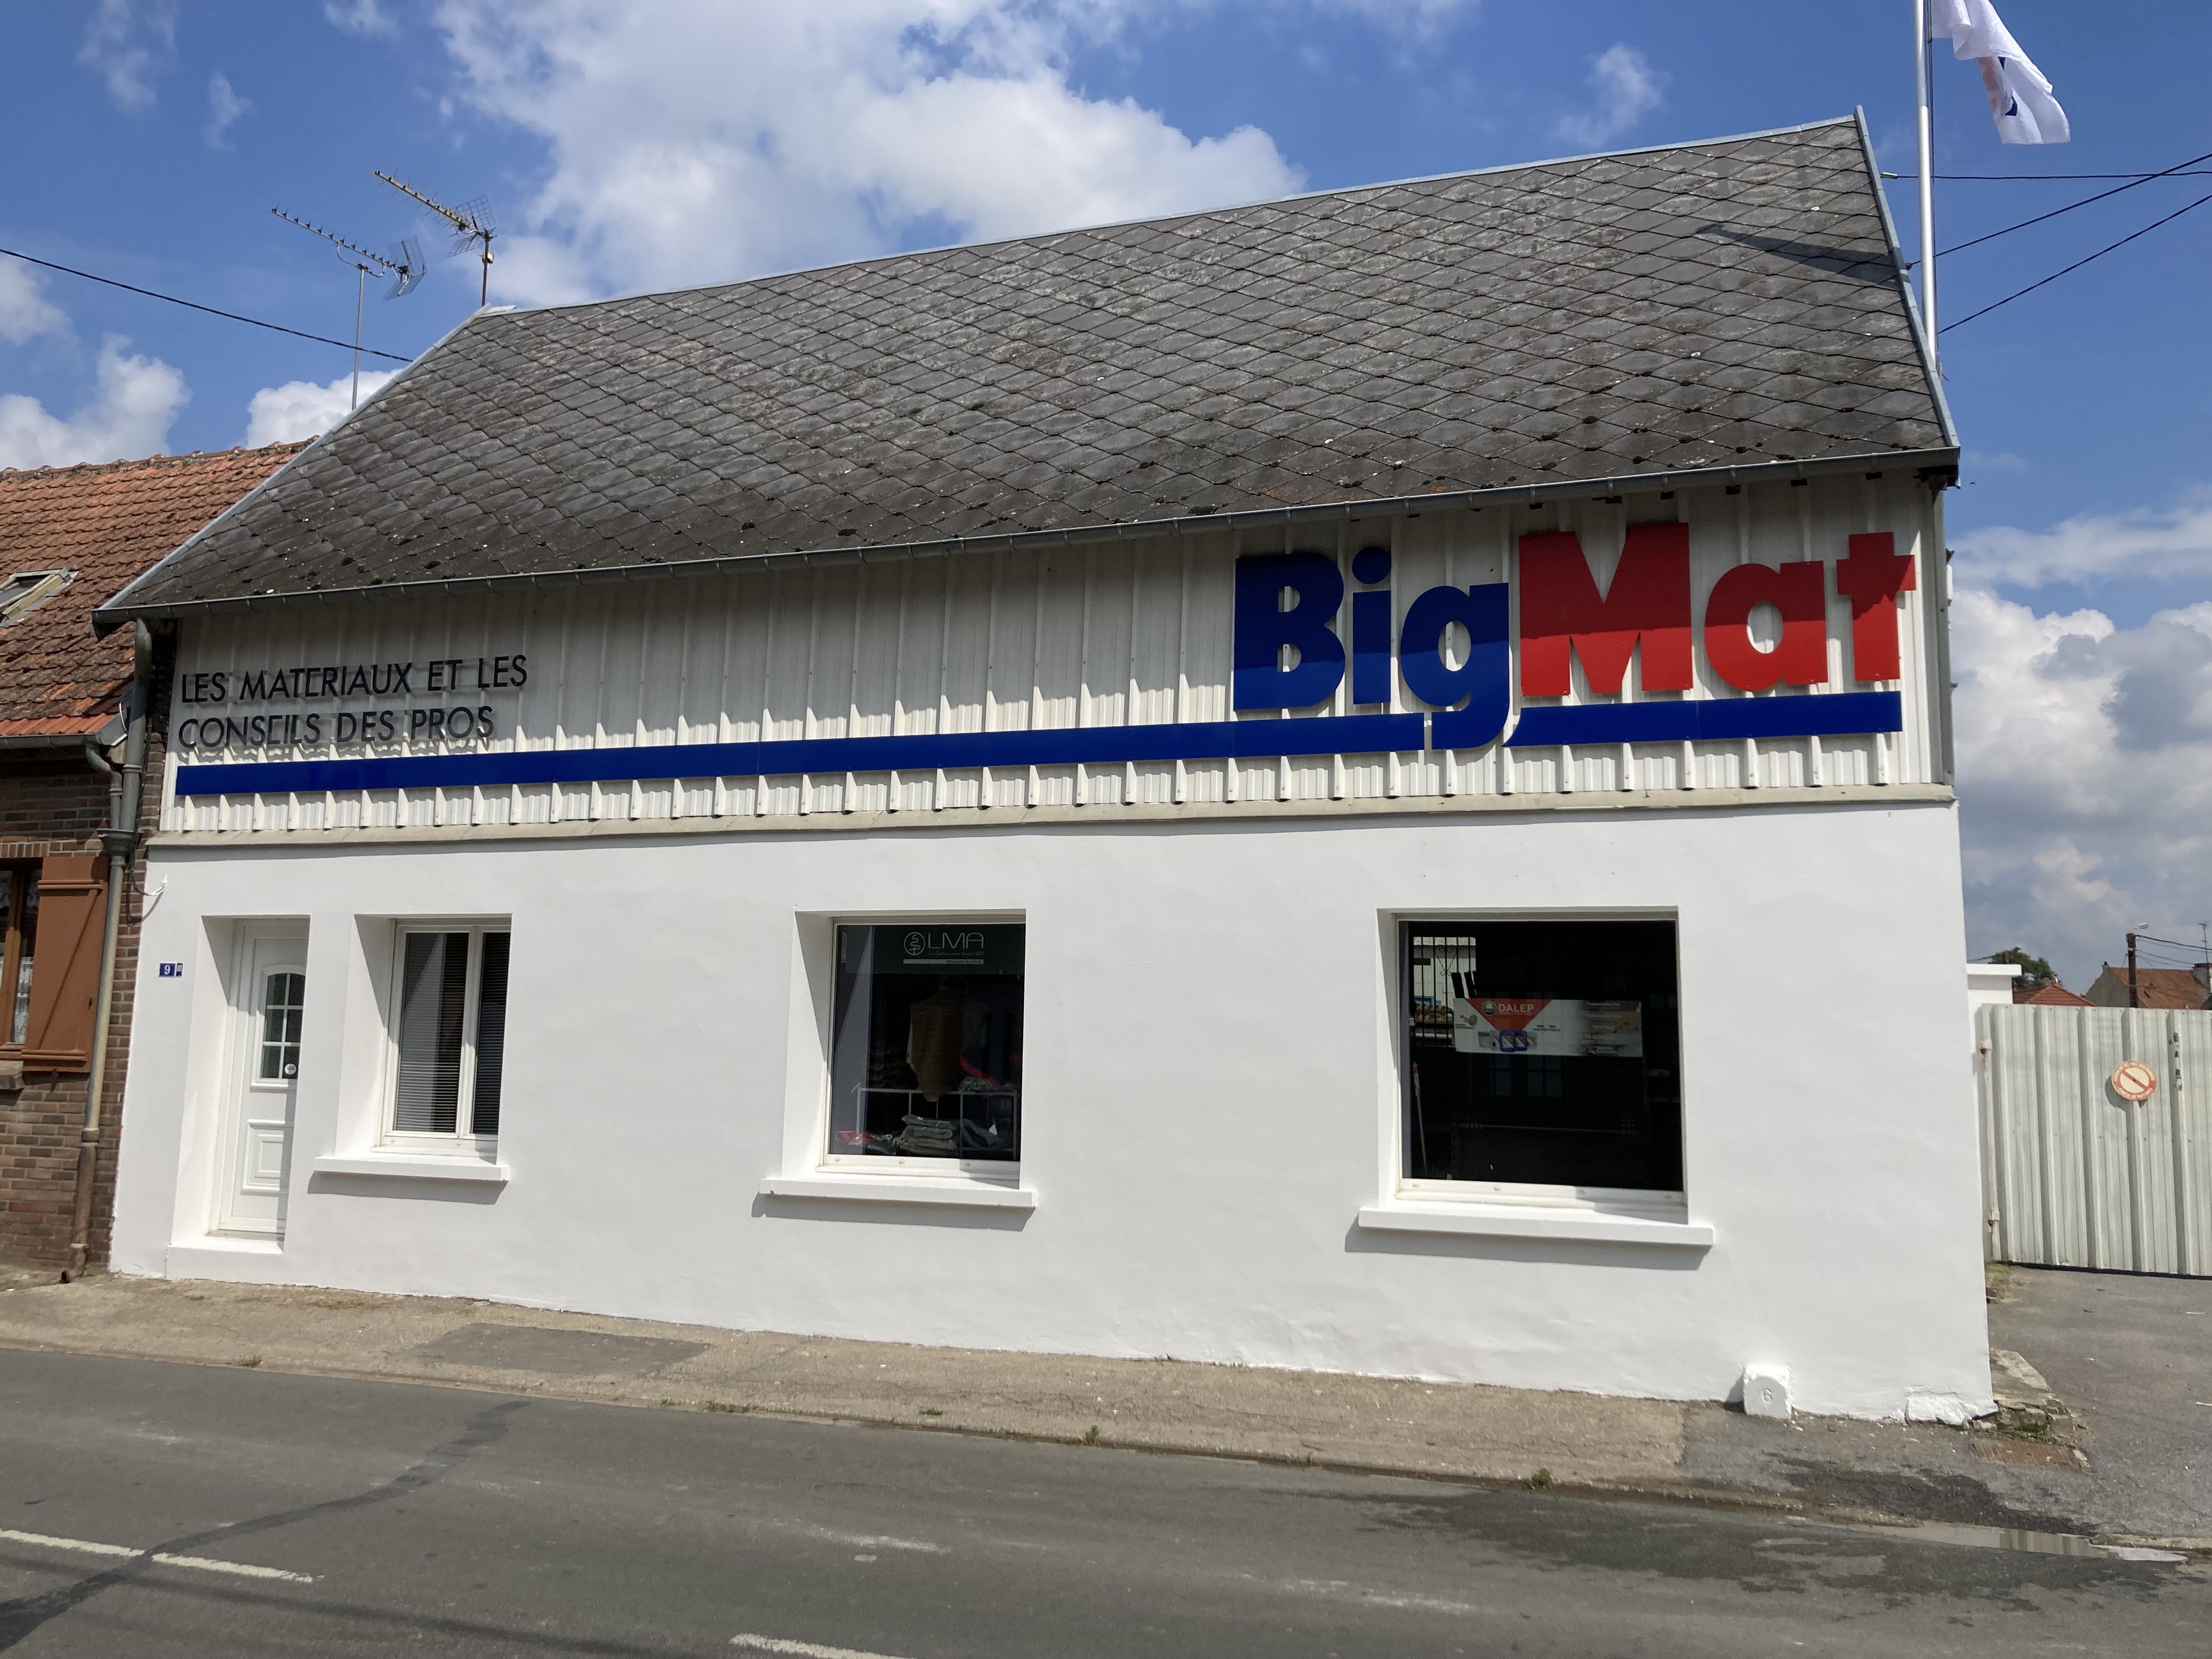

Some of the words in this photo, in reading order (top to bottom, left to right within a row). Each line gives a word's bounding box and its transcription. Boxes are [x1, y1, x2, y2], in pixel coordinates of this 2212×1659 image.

[1233, 522, 1916, 749] BigMat
[182, 672, 226, 703] LES
[239, 662, 413, 701] MATERIAUX
[428, 659, 463, 691] ET
[478, 654, 527, 689] LES
[178, 713, 321, 748] CONSEILS
[337, 710, 395, 743] DES
[411, 706, 493, 740] PROS
[928, 933, 984, 949] LMA
[164, 964, 171, 975] 9
[1498, 1003, 1533, 1013] DALEP
